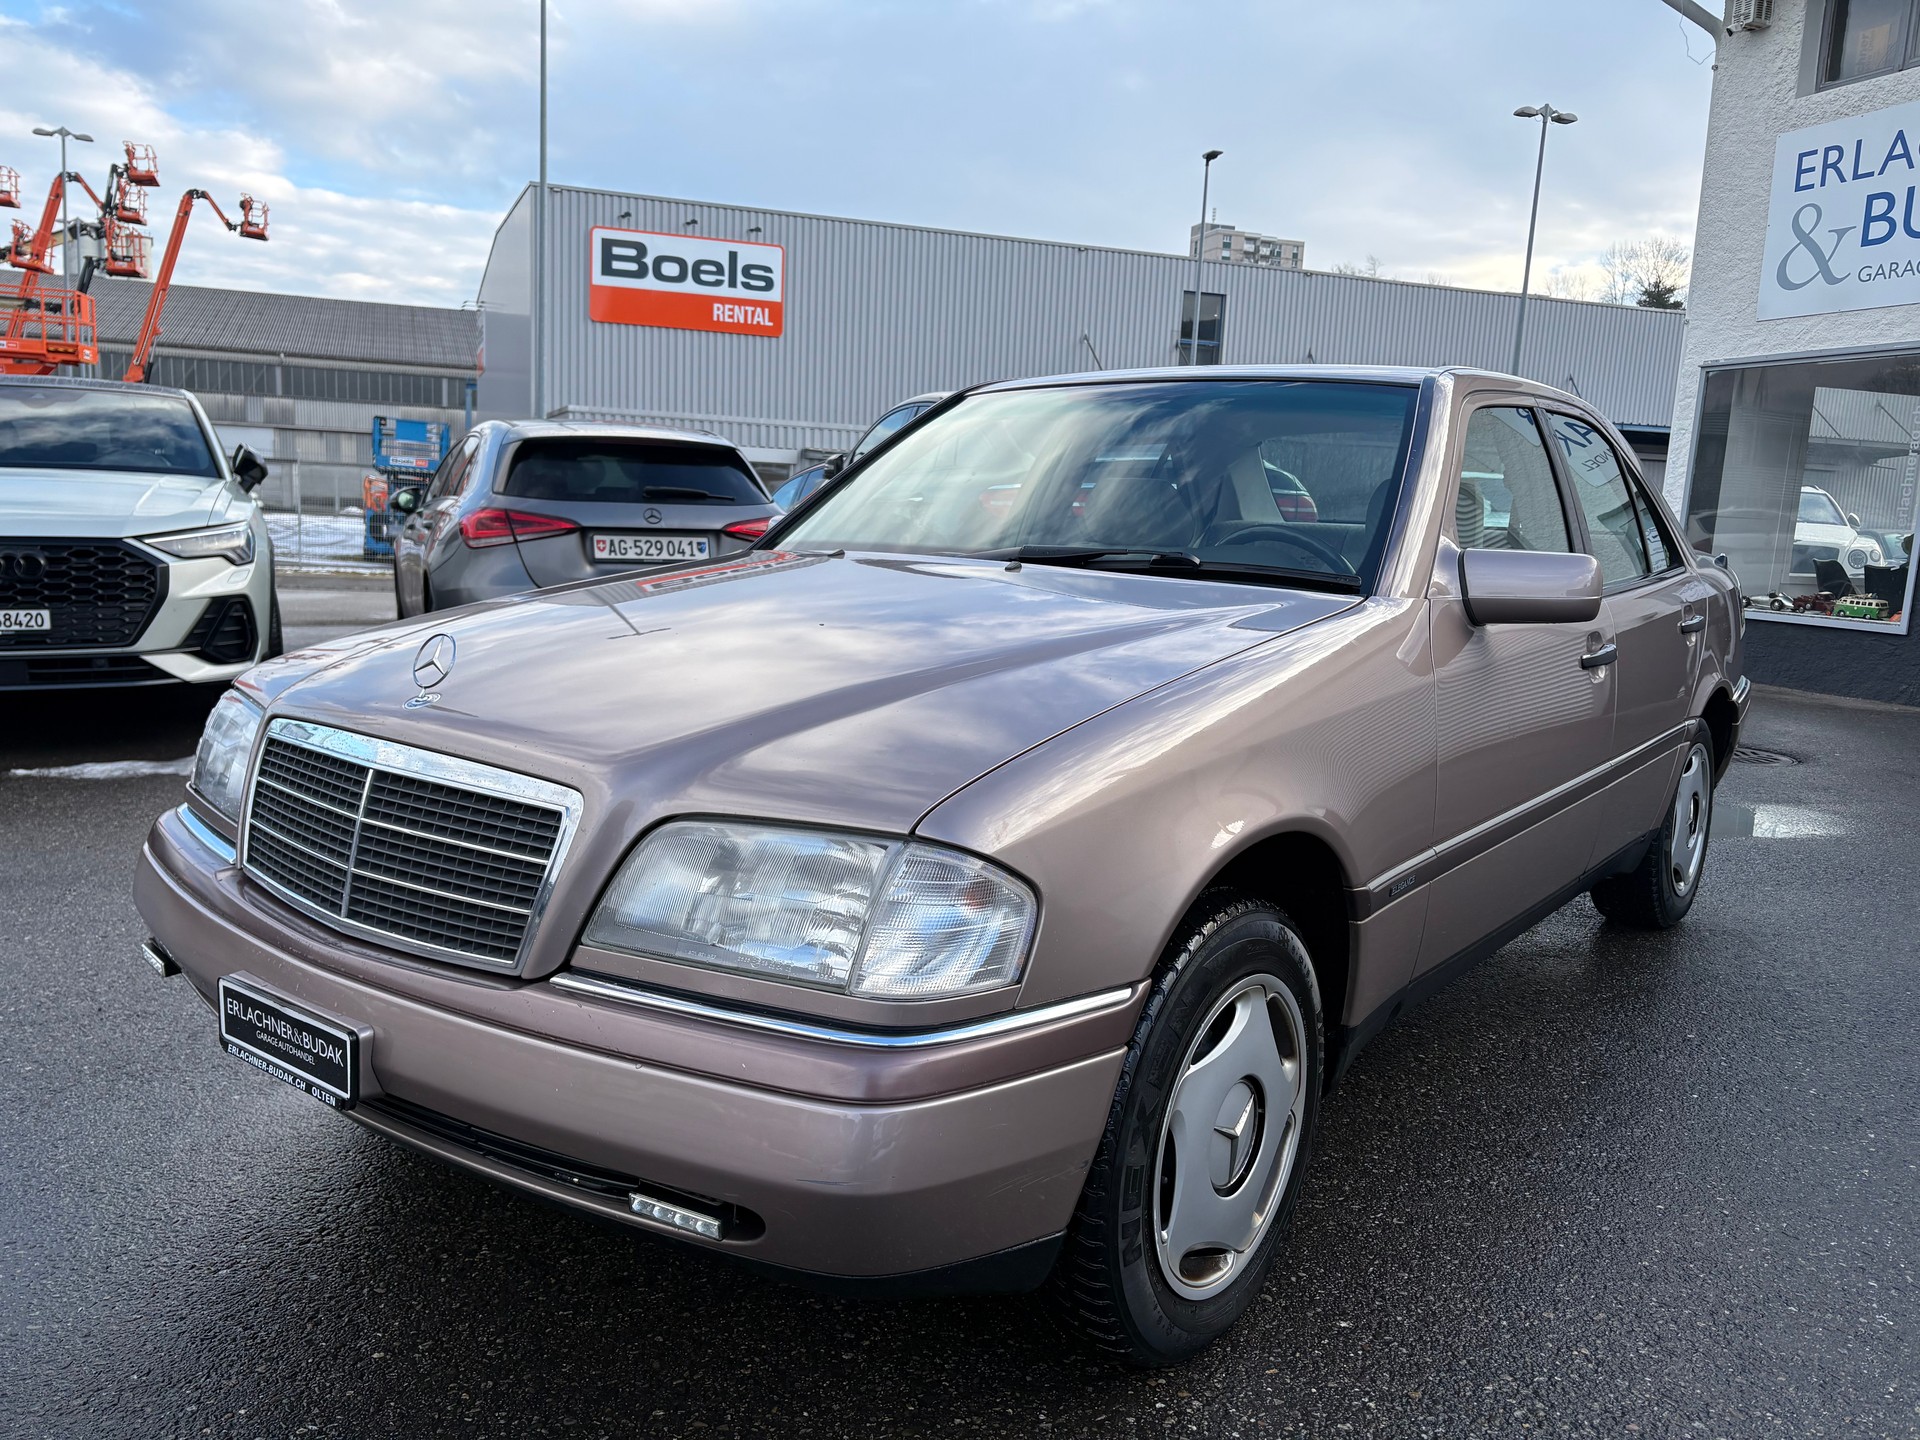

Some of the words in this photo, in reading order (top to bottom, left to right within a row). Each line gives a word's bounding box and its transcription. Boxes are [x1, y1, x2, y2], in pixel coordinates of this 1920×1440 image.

[1794, 128, 1920, 193] ERLA
[601, 237, 775, 292] Boels
[1775, 202, 1857, 291] &
[712, 303, 774, 326] RENTAL
[0, 611, 45, 629] 8420
[226, 997, 344, 1068] ERLACHNER&BUDAK
[227, 1044, 306, 1091] ERLACHNER-BUDAK.CH
[311, 1086, 336, 1107] OLTEN
